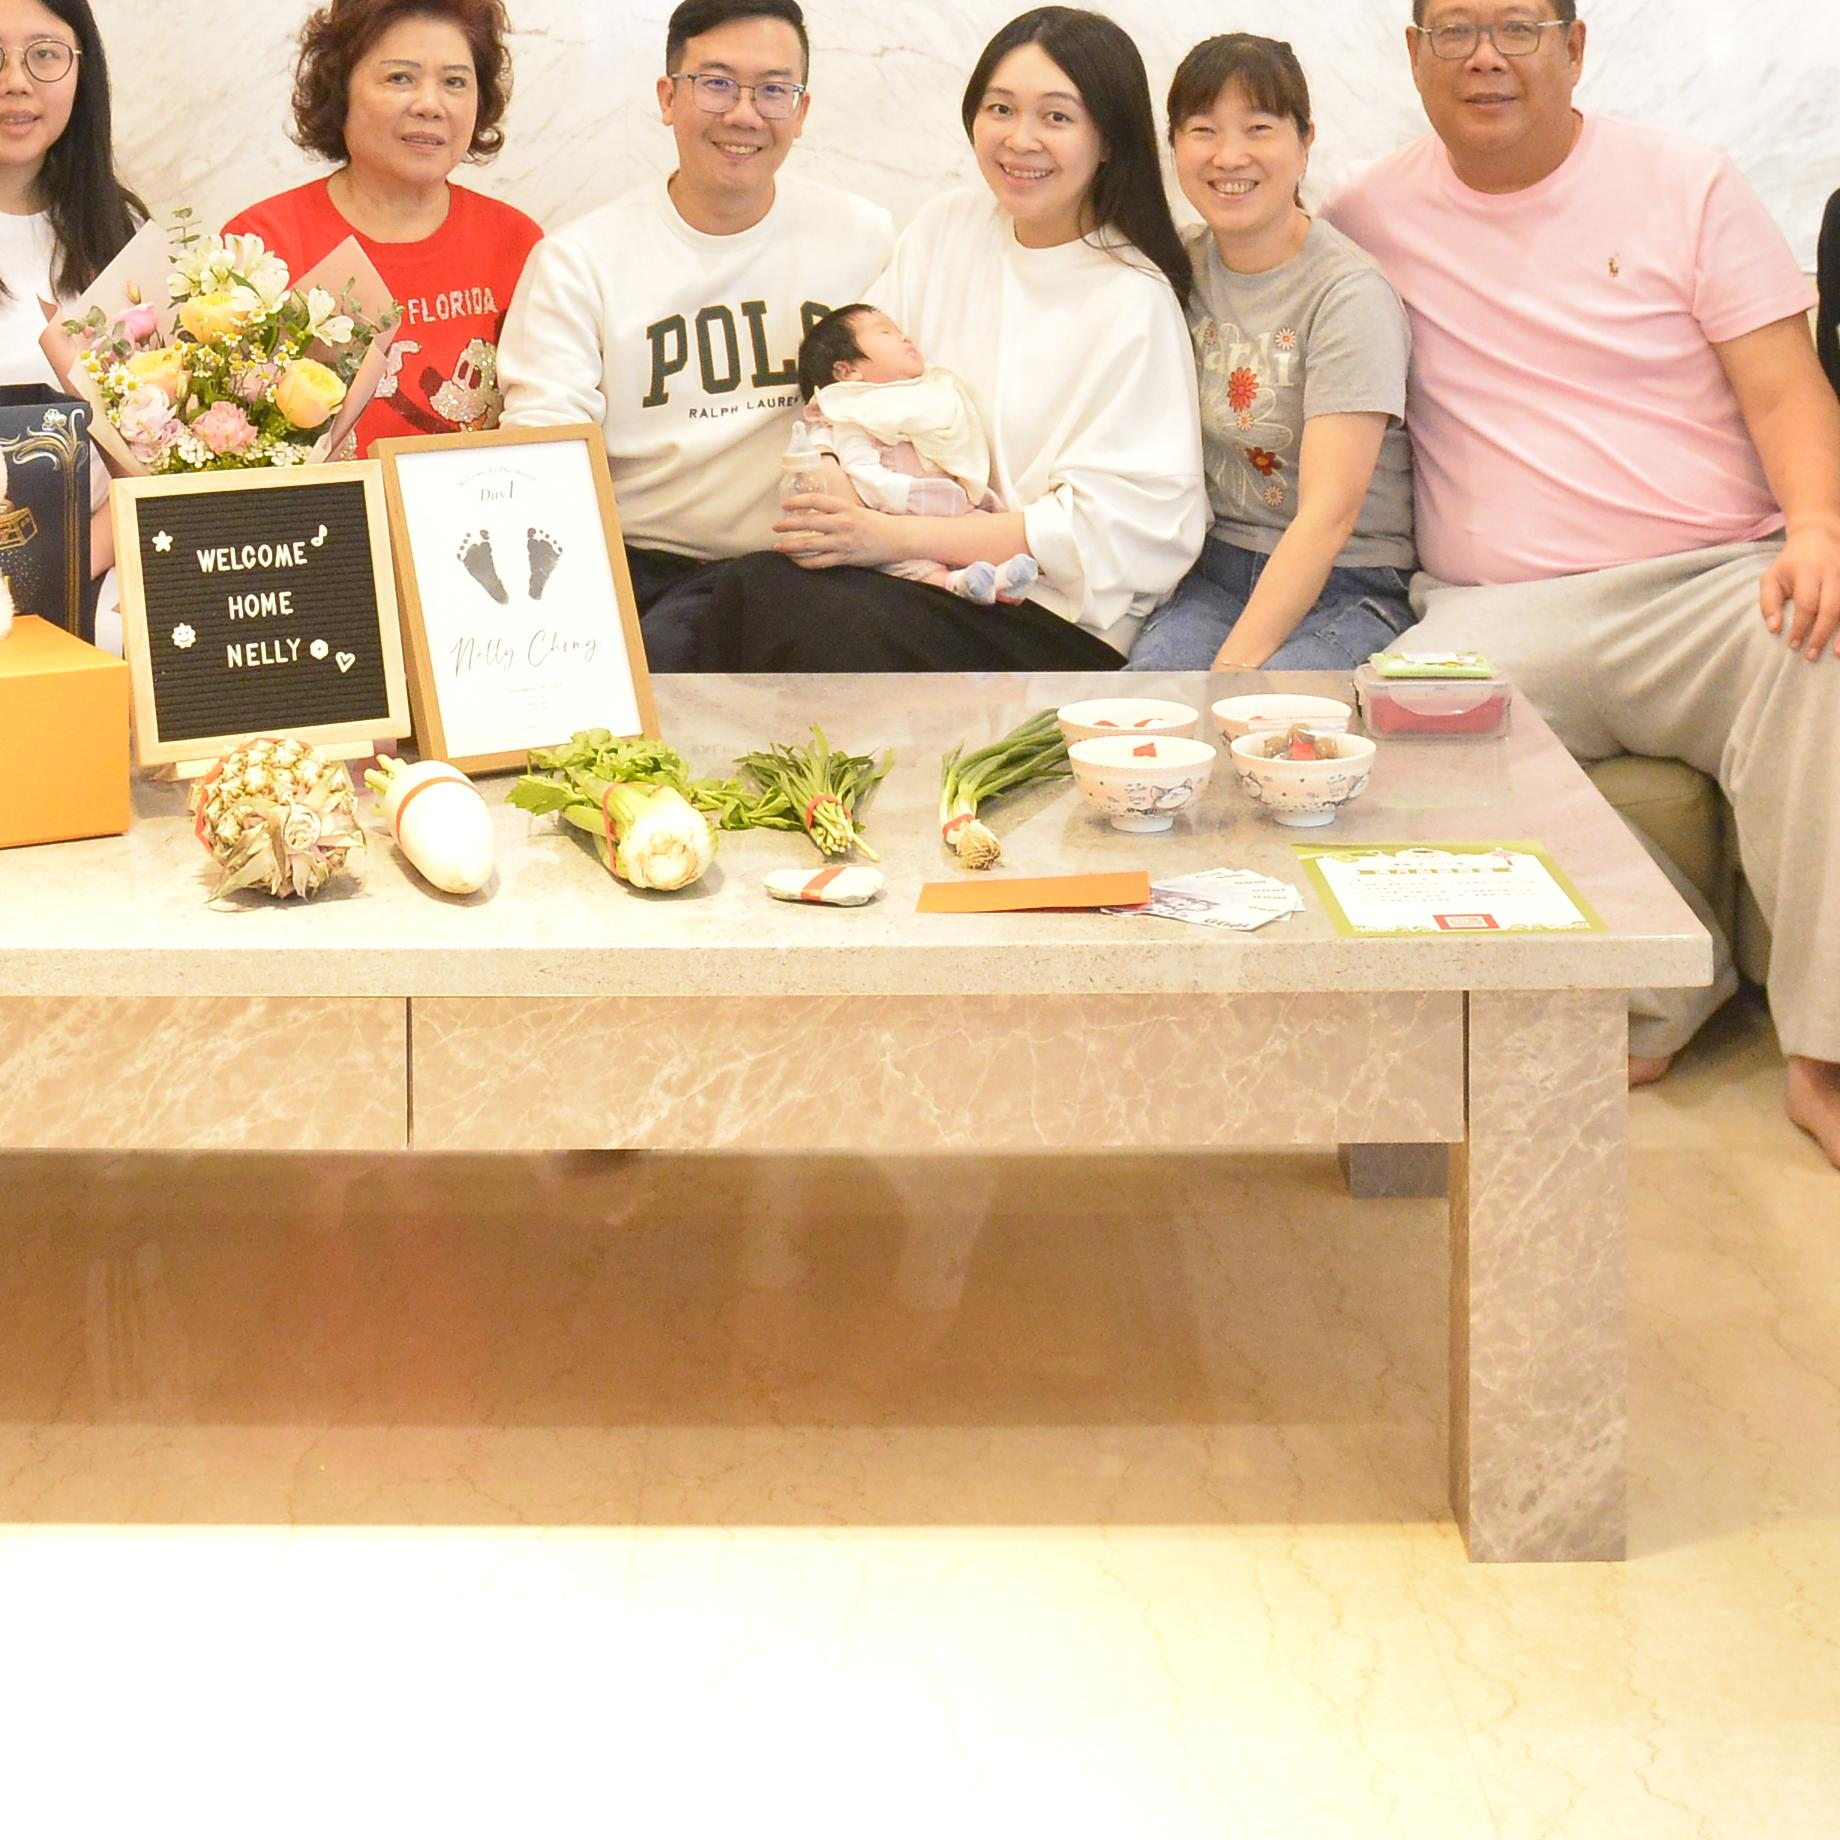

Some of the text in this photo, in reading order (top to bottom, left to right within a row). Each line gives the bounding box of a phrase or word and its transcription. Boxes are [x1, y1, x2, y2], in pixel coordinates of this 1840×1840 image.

[408, 287, 498, 325] FLORIDA
[689, 405, 739, 419] RALPH
[196, 541, 308, 573] WELCOME
[228, 591, 294, 620] HOME
[227, 638, 301, 668] NELLY
